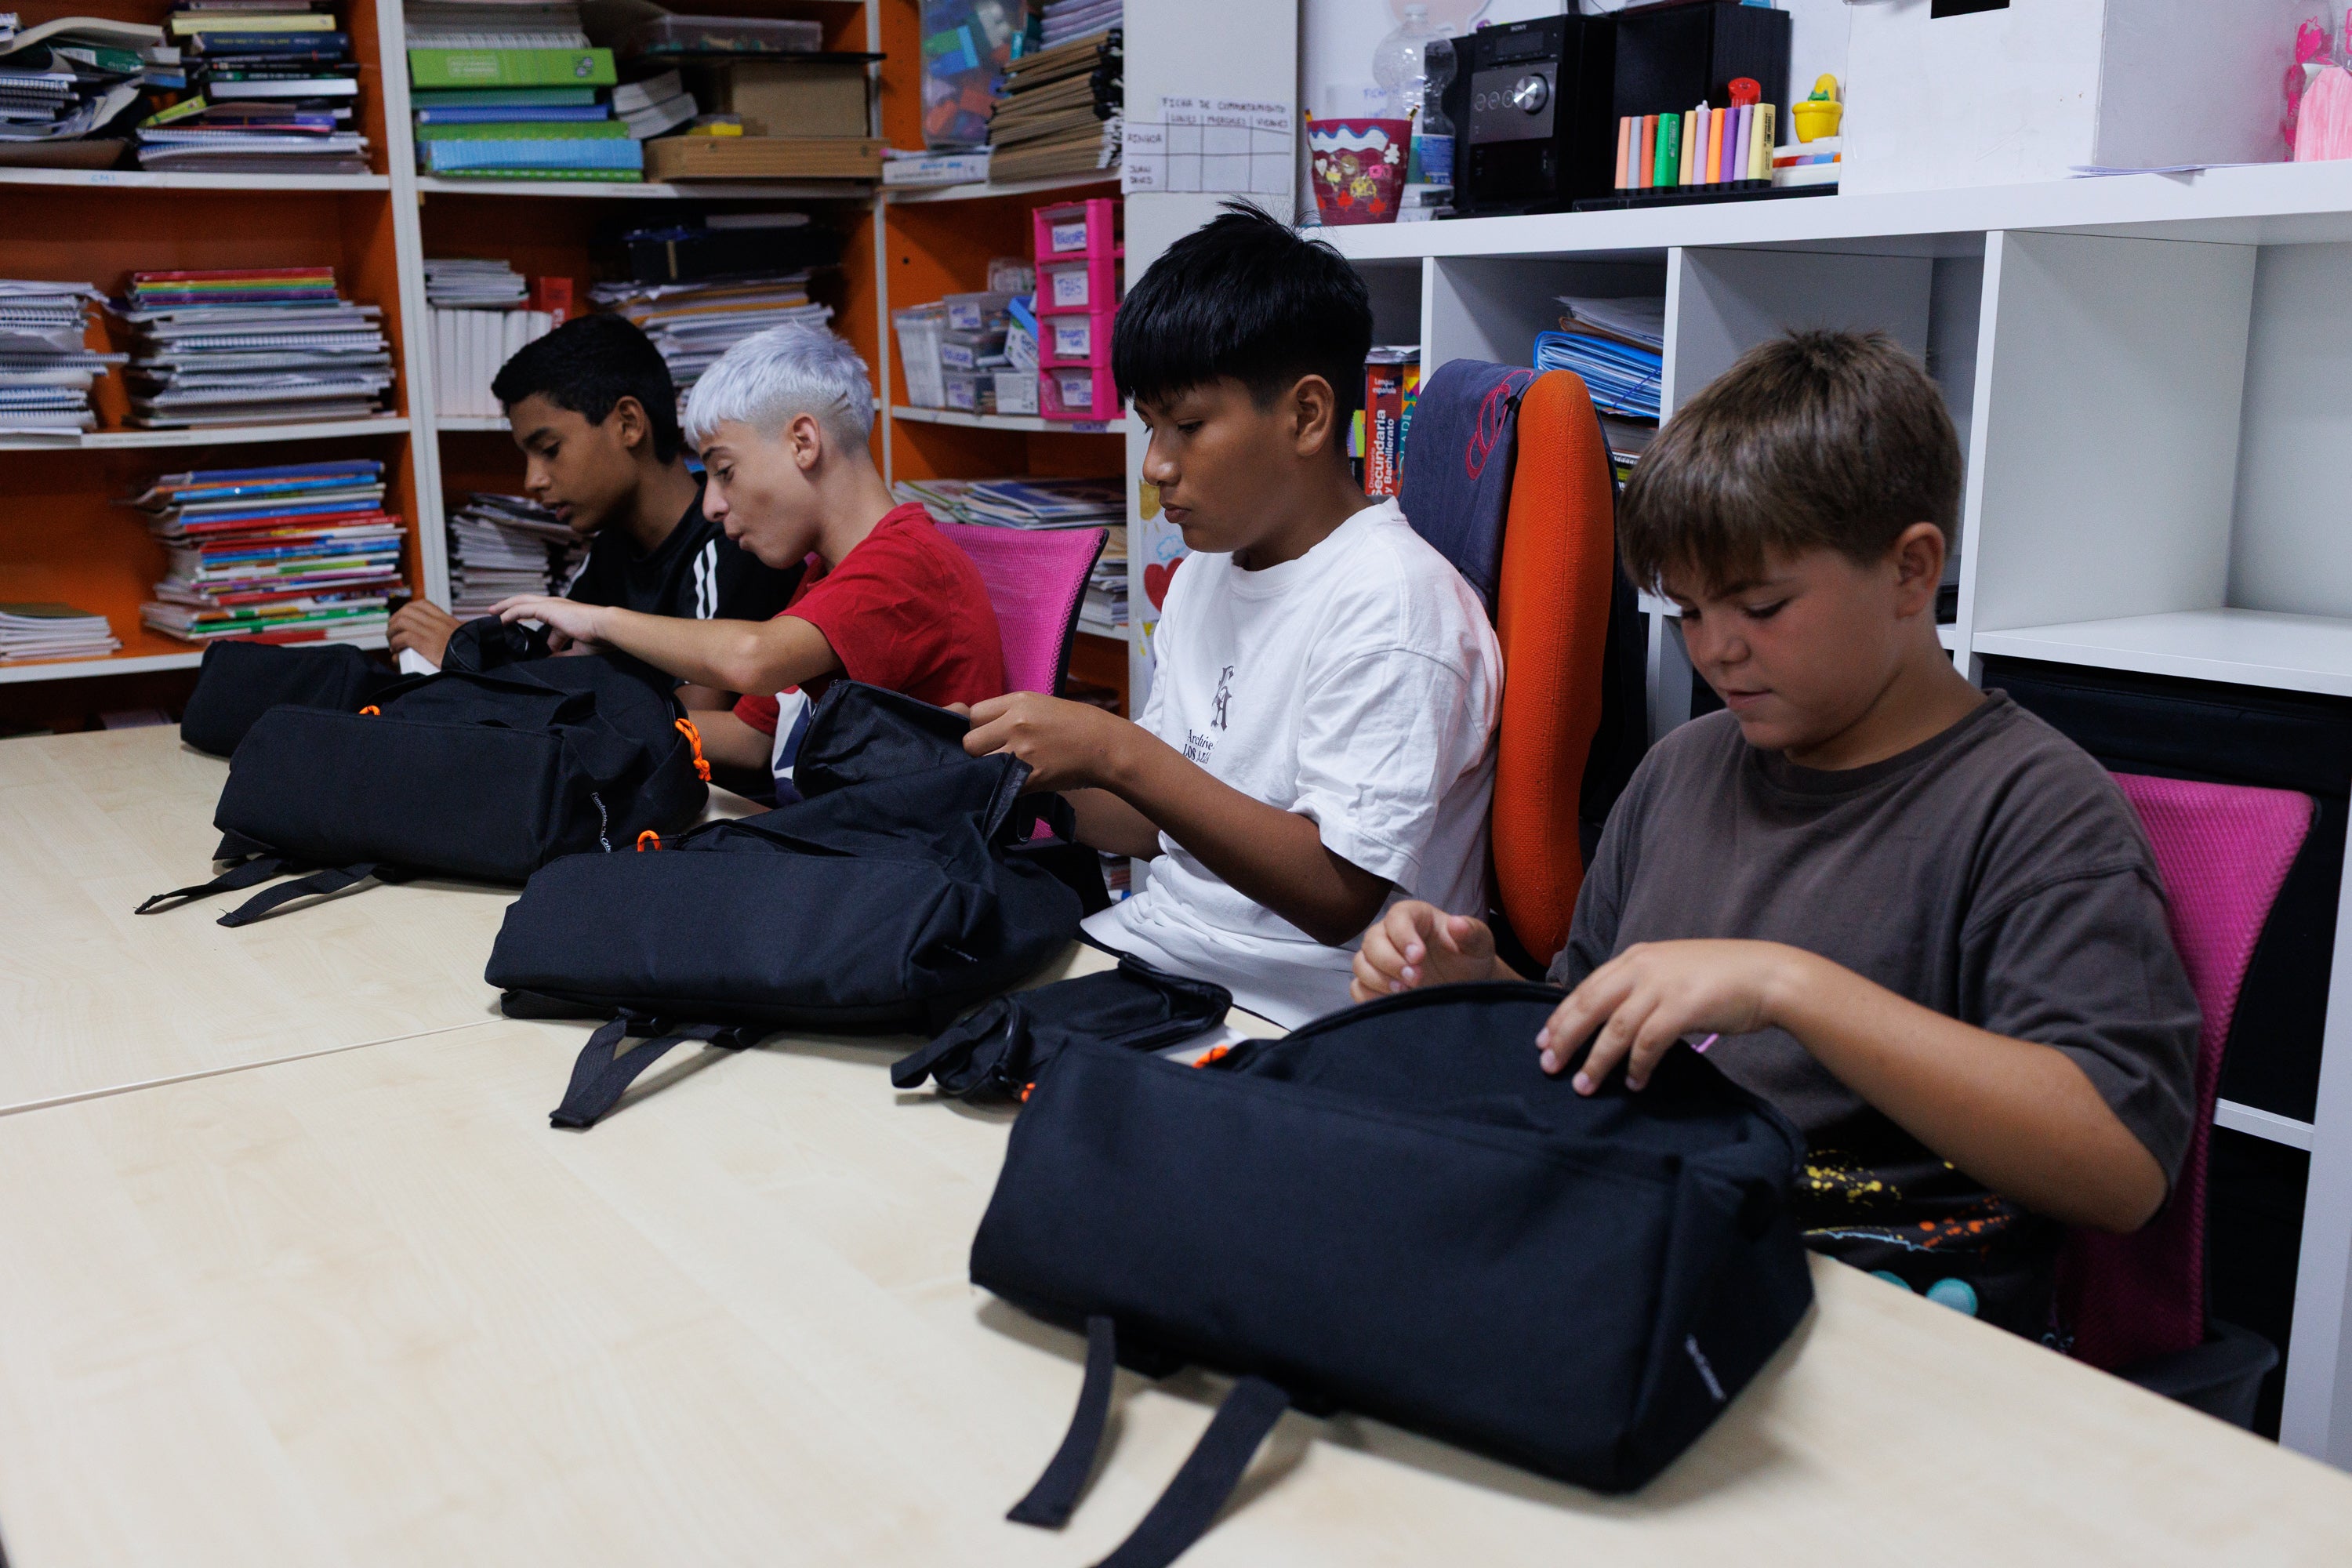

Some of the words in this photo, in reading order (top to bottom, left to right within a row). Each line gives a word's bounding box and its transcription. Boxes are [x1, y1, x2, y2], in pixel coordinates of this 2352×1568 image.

[1384, 419, 1395, 484] Bachillerato
[1187, 729, 1214, 750] Archive
[1183, 743, 1196, 760] LOS
